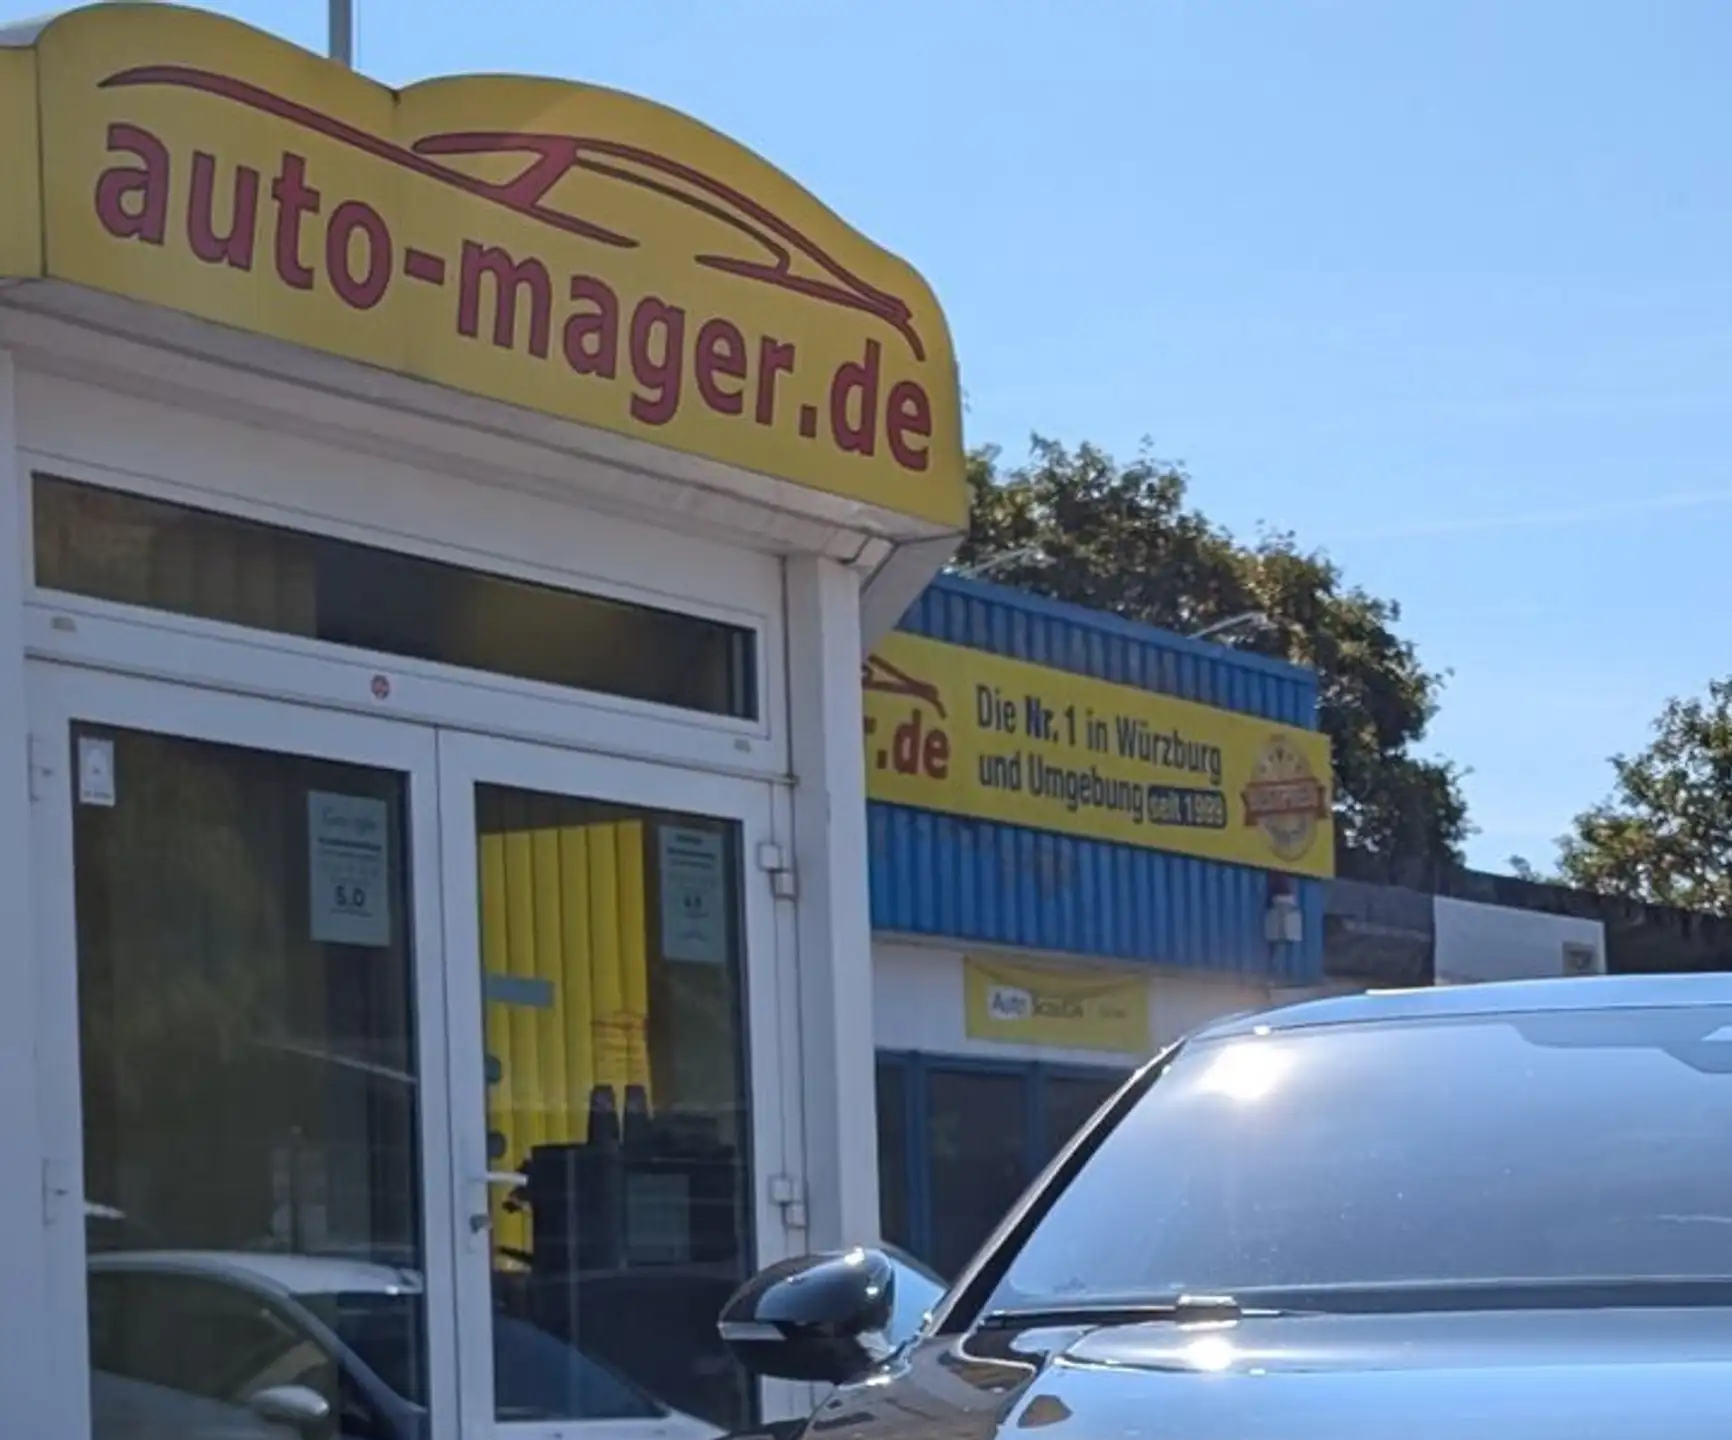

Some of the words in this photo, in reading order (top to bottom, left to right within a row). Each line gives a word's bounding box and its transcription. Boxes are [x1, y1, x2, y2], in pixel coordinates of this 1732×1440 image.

[94, 122, 933, 473] auto-mager.de
[977, 684, 1016, 734] Die
[1087, 706, 1108, 753] in
[1116, 713, 1222, 787] Würzburg
[979, 749, 1021, 791] und
[1028, 751, 1143, 825] Umgebung
